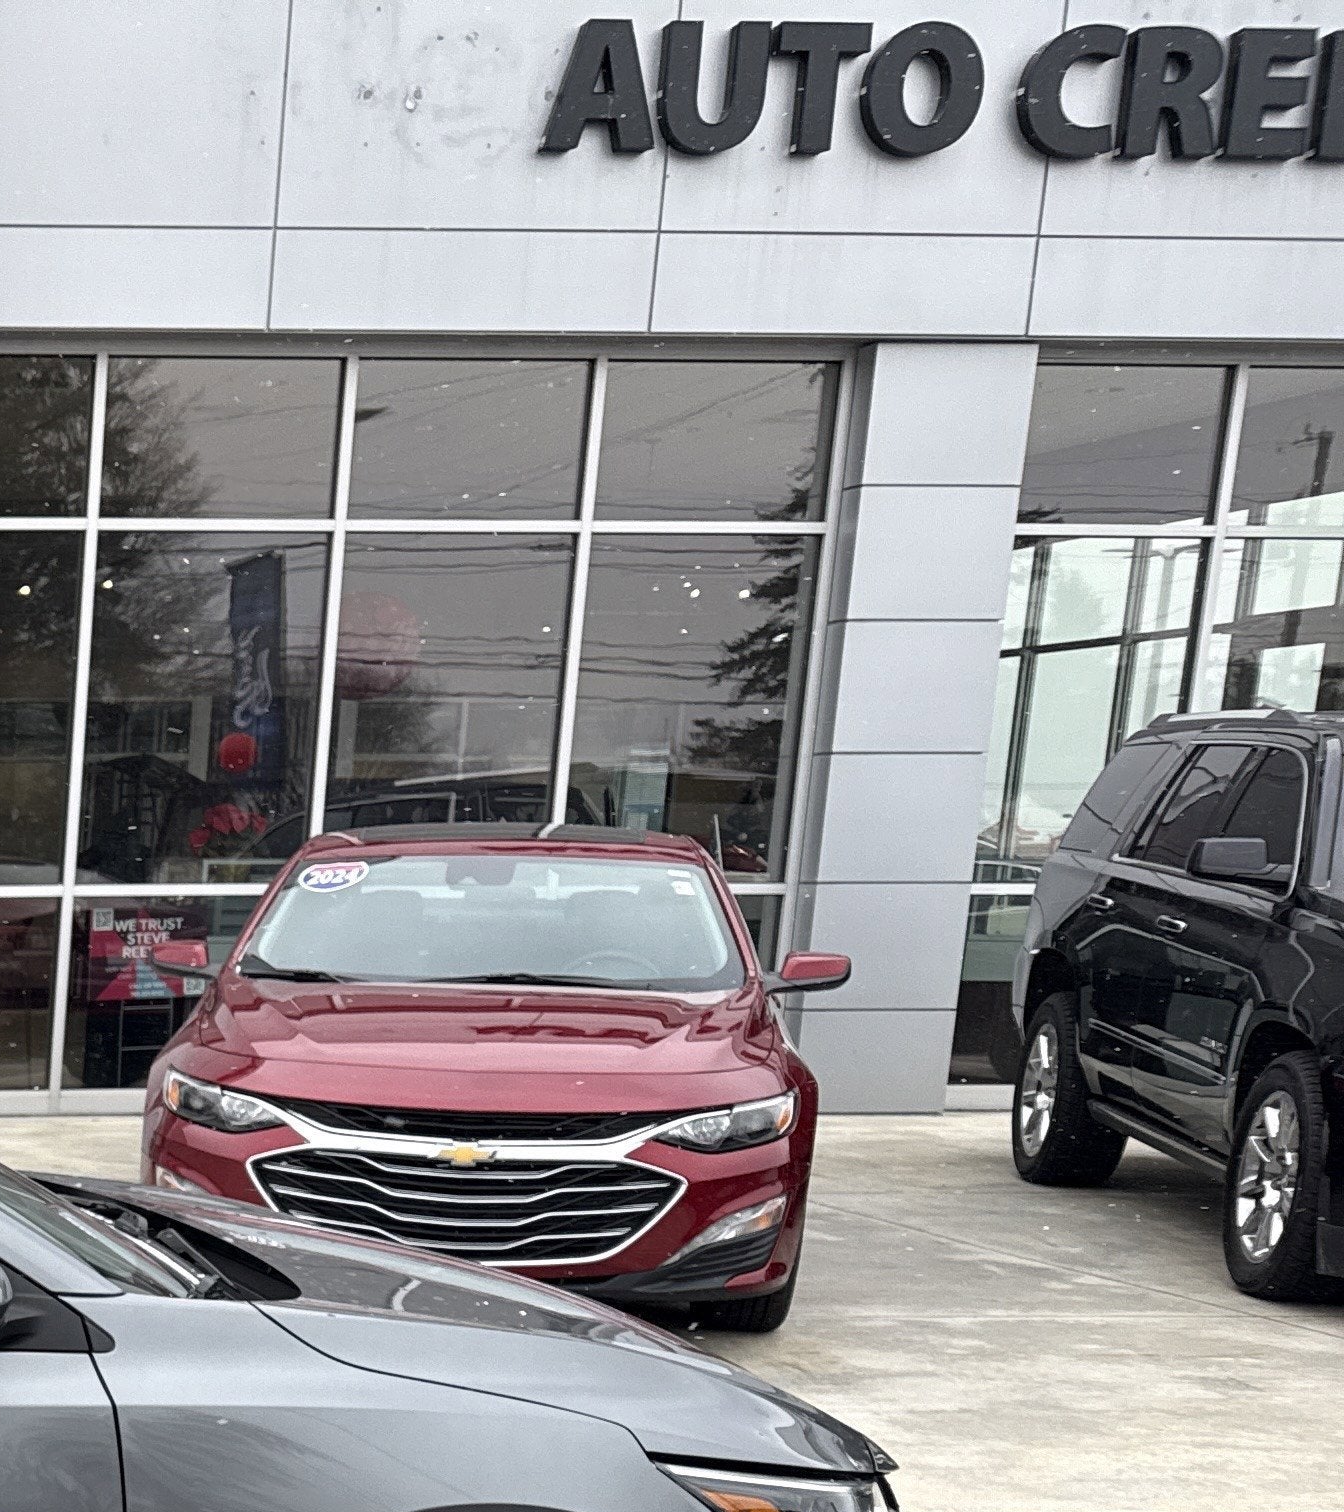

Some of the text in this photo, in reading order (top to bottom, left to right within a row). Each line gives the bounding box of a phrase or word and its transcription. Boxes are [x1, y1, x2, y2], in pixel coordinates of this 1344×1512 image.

[538, 18, 986, 158] AUTO
[114, 916, 185, 933] WE TRUST
[127, 931, 171, 946] STEVE
